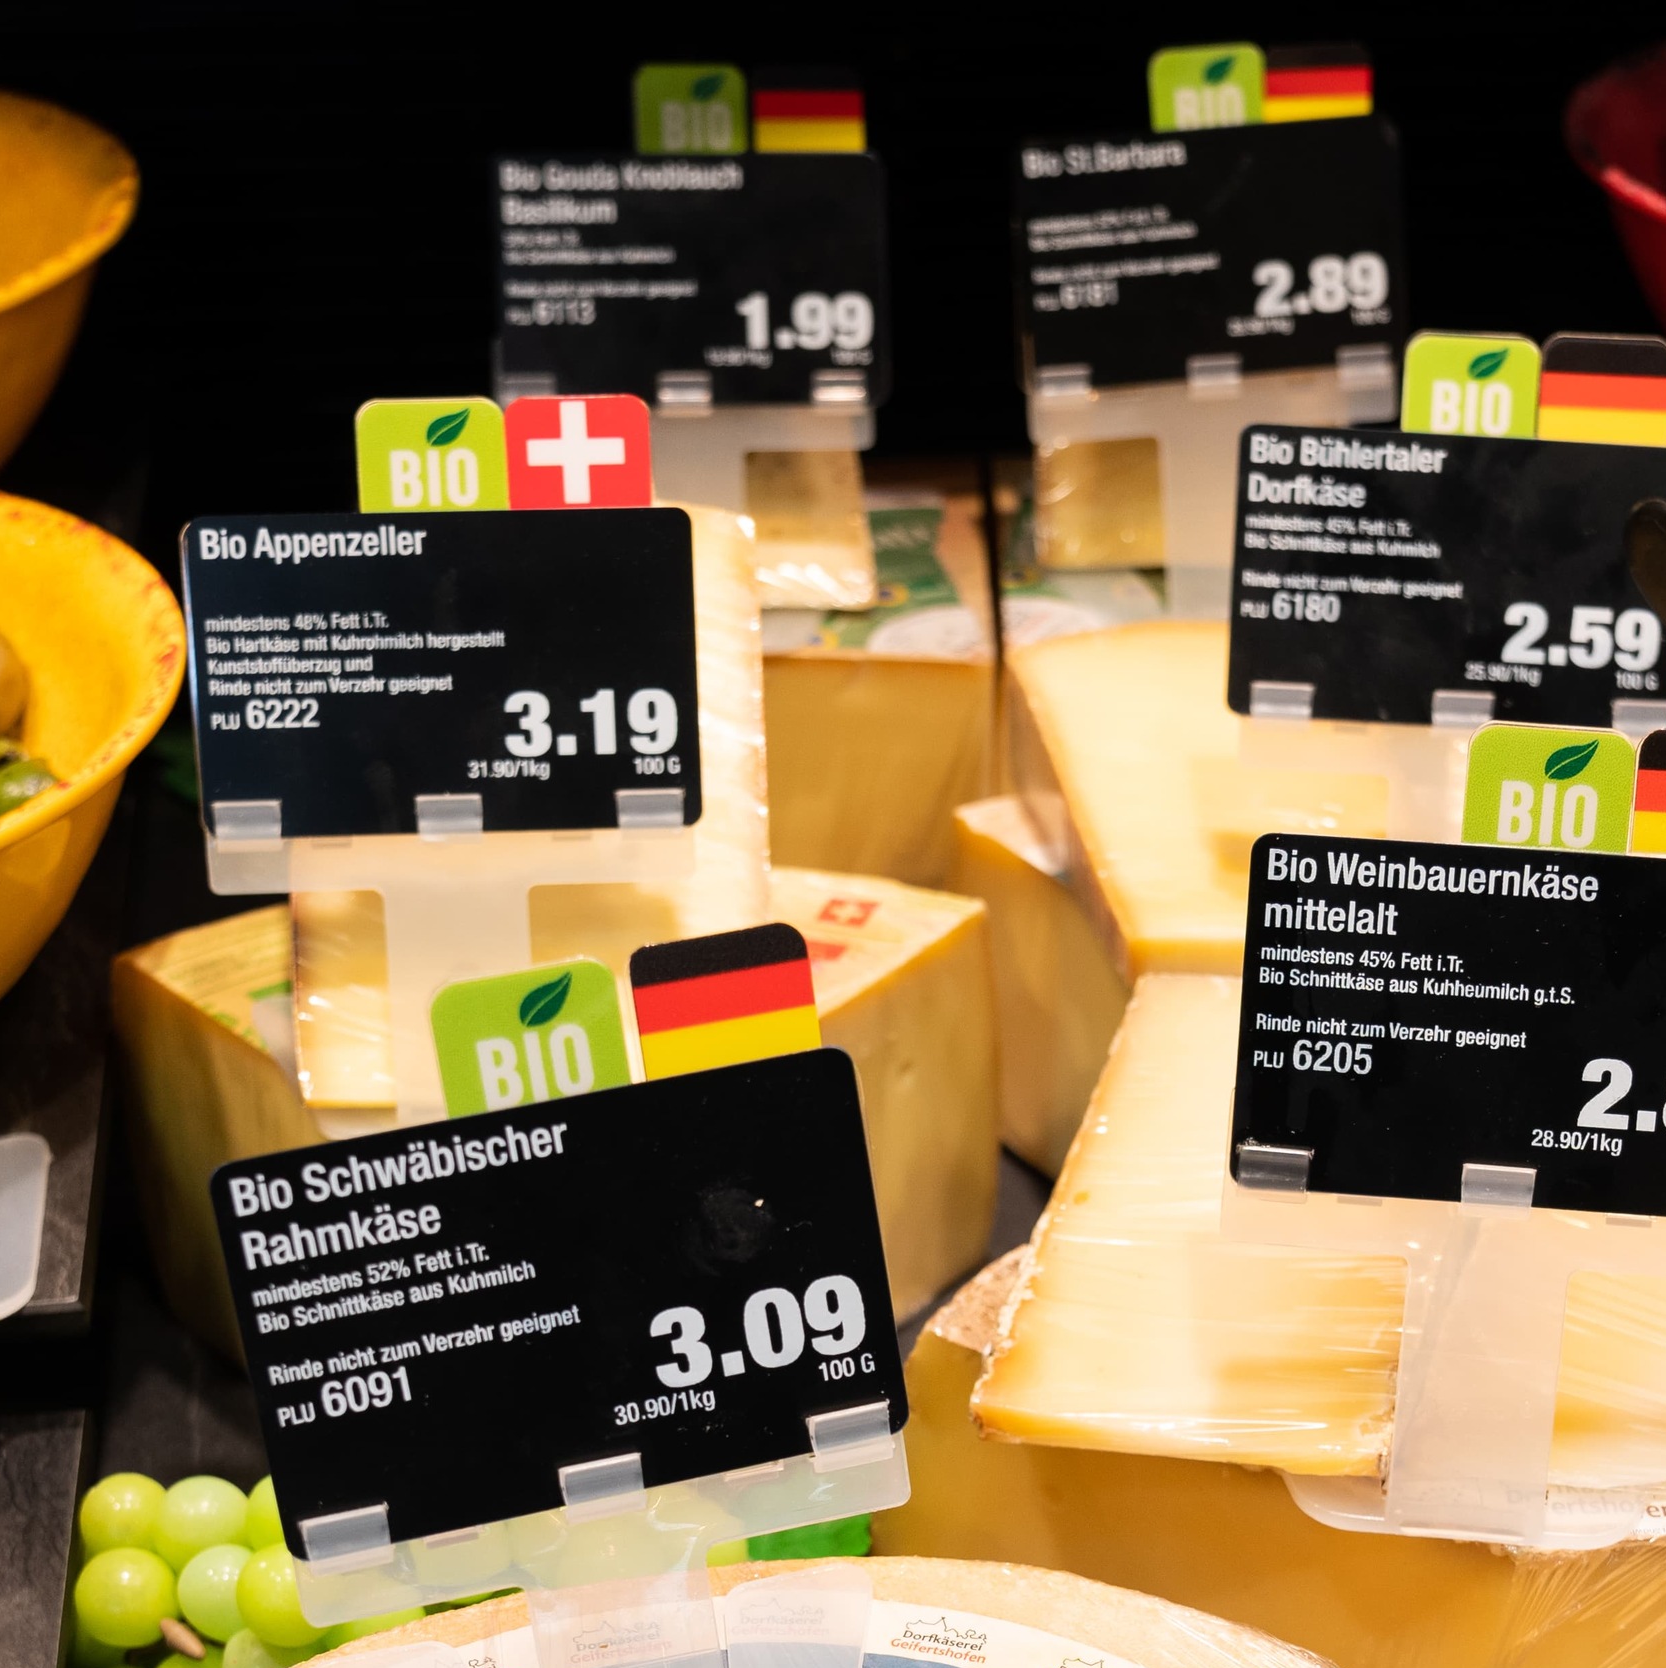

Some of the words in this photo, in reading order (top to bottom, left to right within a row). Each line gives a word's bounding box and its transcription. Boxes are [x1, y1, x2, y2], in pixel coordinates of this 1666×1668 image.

[500, 162, 542, 191] Bio
[1022, 149, 1064, 178] Bio
[501, 195, 617, 225] Basilikum
[1252, 251, 1389, 319] 2.89
[735, 291, 875, 351] 1.99
[1430, 380, 1513, 435] BIO
[1250, 434, 1294, 465] Bio
[1300, 436, 1447, 473] Bühlertaler
[389, 448, 480, 508] BIO
[1248, 472, 1366, 508] Dorfkäse
[199, 529, 246, 560] Bio
[253, 525, 426, 564] Appenzeller
[205, 616, 290, 632] mindestens
[293, 614, 327, 630] 48%
[331, 613, 360, 629] Fett
[1272, 592, 1340, 622] 6180
[206, 637, 230, 654] Bio
[234, 636, 299, 653] Hartkäse
[303, 635, 328, 651] mit
[331, 633, 424, 651] Kuhrohmilch
[426, 631, 505, 651] hergestellt
[1501, 601, 1662, 671] 2.59
[207, 657, 341, 675] Kunststoffüberzug
[344, 656, 373, 671] und
[208, 679, 251, 696] Rinde
[254, 678, 292, 695] nicht
[295, 680, 327, 694] zum
[328, 676, 386, 693] Verzehr
[388, 676, 452, 695] geeignet
[211, 714, 240, 730] PLU
[246, 698, 320, 729] 6222
[504, 689, 679, 757] 3.19
[468, 759, 550, 780] 31.90/1kg
[634, 756, 664, 774] 100
[1496, 780, 1598, 848] BIO
[1268, 848, 1317, 883] Bio
[1328, 852, 1598, 901] Weinbauernkäse
[1265, 898, 1398, 935] mittelalt
[1261, 945, 1354, 965] mindestens
[1359, 950, 1395, 968] 45%
[1401, 953, 1433, 971] Fett
[1437, 955, 1463, 972] i.Tr.
[1260, 967, 1284, 984] Bio
[1290, 969, 1384, 991] Schnittkäse
[1389, 979, 1418, 993] aus
[1424, 978, 1529, 1001] Kuhheumilch
[1534, 987, 1575, 1005] g.t.S.
[1256, 1013, 1301, 1032] Rinde
[1306, 1017, 1347, 1035] nicht
[1351, 1024, 1385, 1037] zum
[1390, 1022, 1451, 1042] Verzehr
[1456, 1029, 1526, 1049] geeignet
[476, 1023, 595, 1112] BIO
[1254, 1051, 1284, 1068] PLU
[1293, 1040, 1372, 1074] 6205
[1531, 1129, 1622, 1156] 28.90/1kg
[229, 1174, 293, 1217] Bio
[302, 1124, 567, 1202] Schwäbischer
[241, 1204, 441, 1270] Rahmkäse
[252, 1271, 363, 1307] mindestens
[366, 1259, 410, 1284] 52%
[414, 1250, 453, 1274] Fett
[456, 1243, 489, 1265] i.Tr.
[257, 1312, 289, 1333] Bio
[293, 1290, 404, 1326] Schnittkäse
[409, 1282, 443, 1303] aus
[447, 1261, 536, 1294] Kuhmilch
[268, 1360, 324, 1385] Rinde
[328, 1347, 377, 1373] nicht
[380, 1341, 421, 1362] zum
[422, 1324, 494, 1353] Verzehr
[500, 1305, 580, 1342] geeignet
[649, 1275, 867, 1389] 3.09
[819, 1357, 855, 1381] 100
[861, 1353, 875, 1373] G
[278, 1402, 315, 1427] PLU
[322, 1366, 411, 1417] 6091
[614, 1390, 715, 1425] 30.90/1kg
[890, 1637, 987, 1665] Geifertshofen
[903, 1629, 983, 1652] Dorfkäserei
